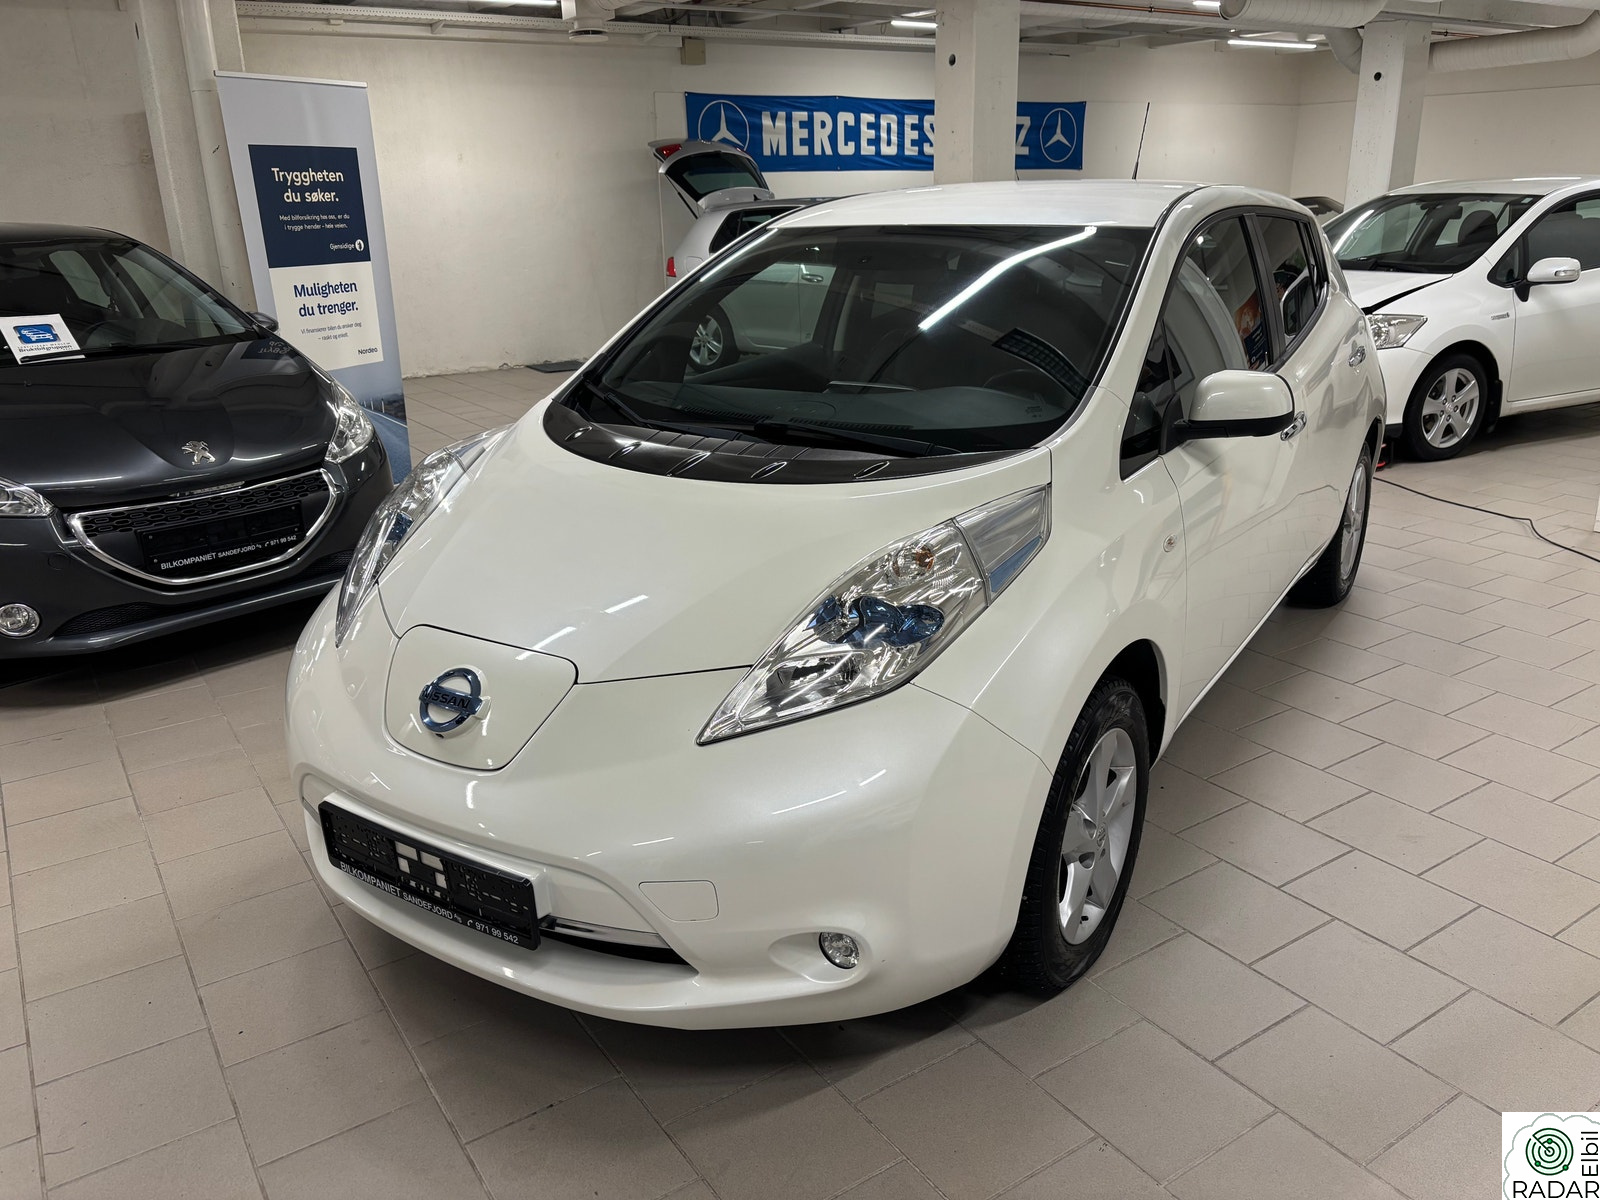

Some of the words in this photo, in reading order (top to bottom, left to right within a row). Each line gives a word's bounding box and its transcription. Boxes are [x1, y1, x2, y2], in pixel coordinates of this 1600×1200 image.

[271, 168, 344, 186] Tryggheten
[284, 189, 301, 202] du
[305, 188, 339, 202] søker.
[291, 214, 320, 222] bilforsikring
[287, 224, 303, 232] trygge
[330, 243, 355, 251] Gjensidige
[294, 282, 357, 298] Muligheten
[298, 303, 315, 317] du
[317, 301, 359, 315] trenger.
[358, 347, 378, 355] Nordea
[160, 552, 217, 570] BILKOMPANIET
[217, 544, 256, 558] SANDEFJORD
[422, 690, 471, 709] NISSAN
[340, 861, 401, 897] BILKOMPANIET
[402, 892, 453, 920] SANDEFJORD
[475, 922, 489, 934] 971
[491, 927, 502, 938] 99
[503, 932, 519, 944] 542
